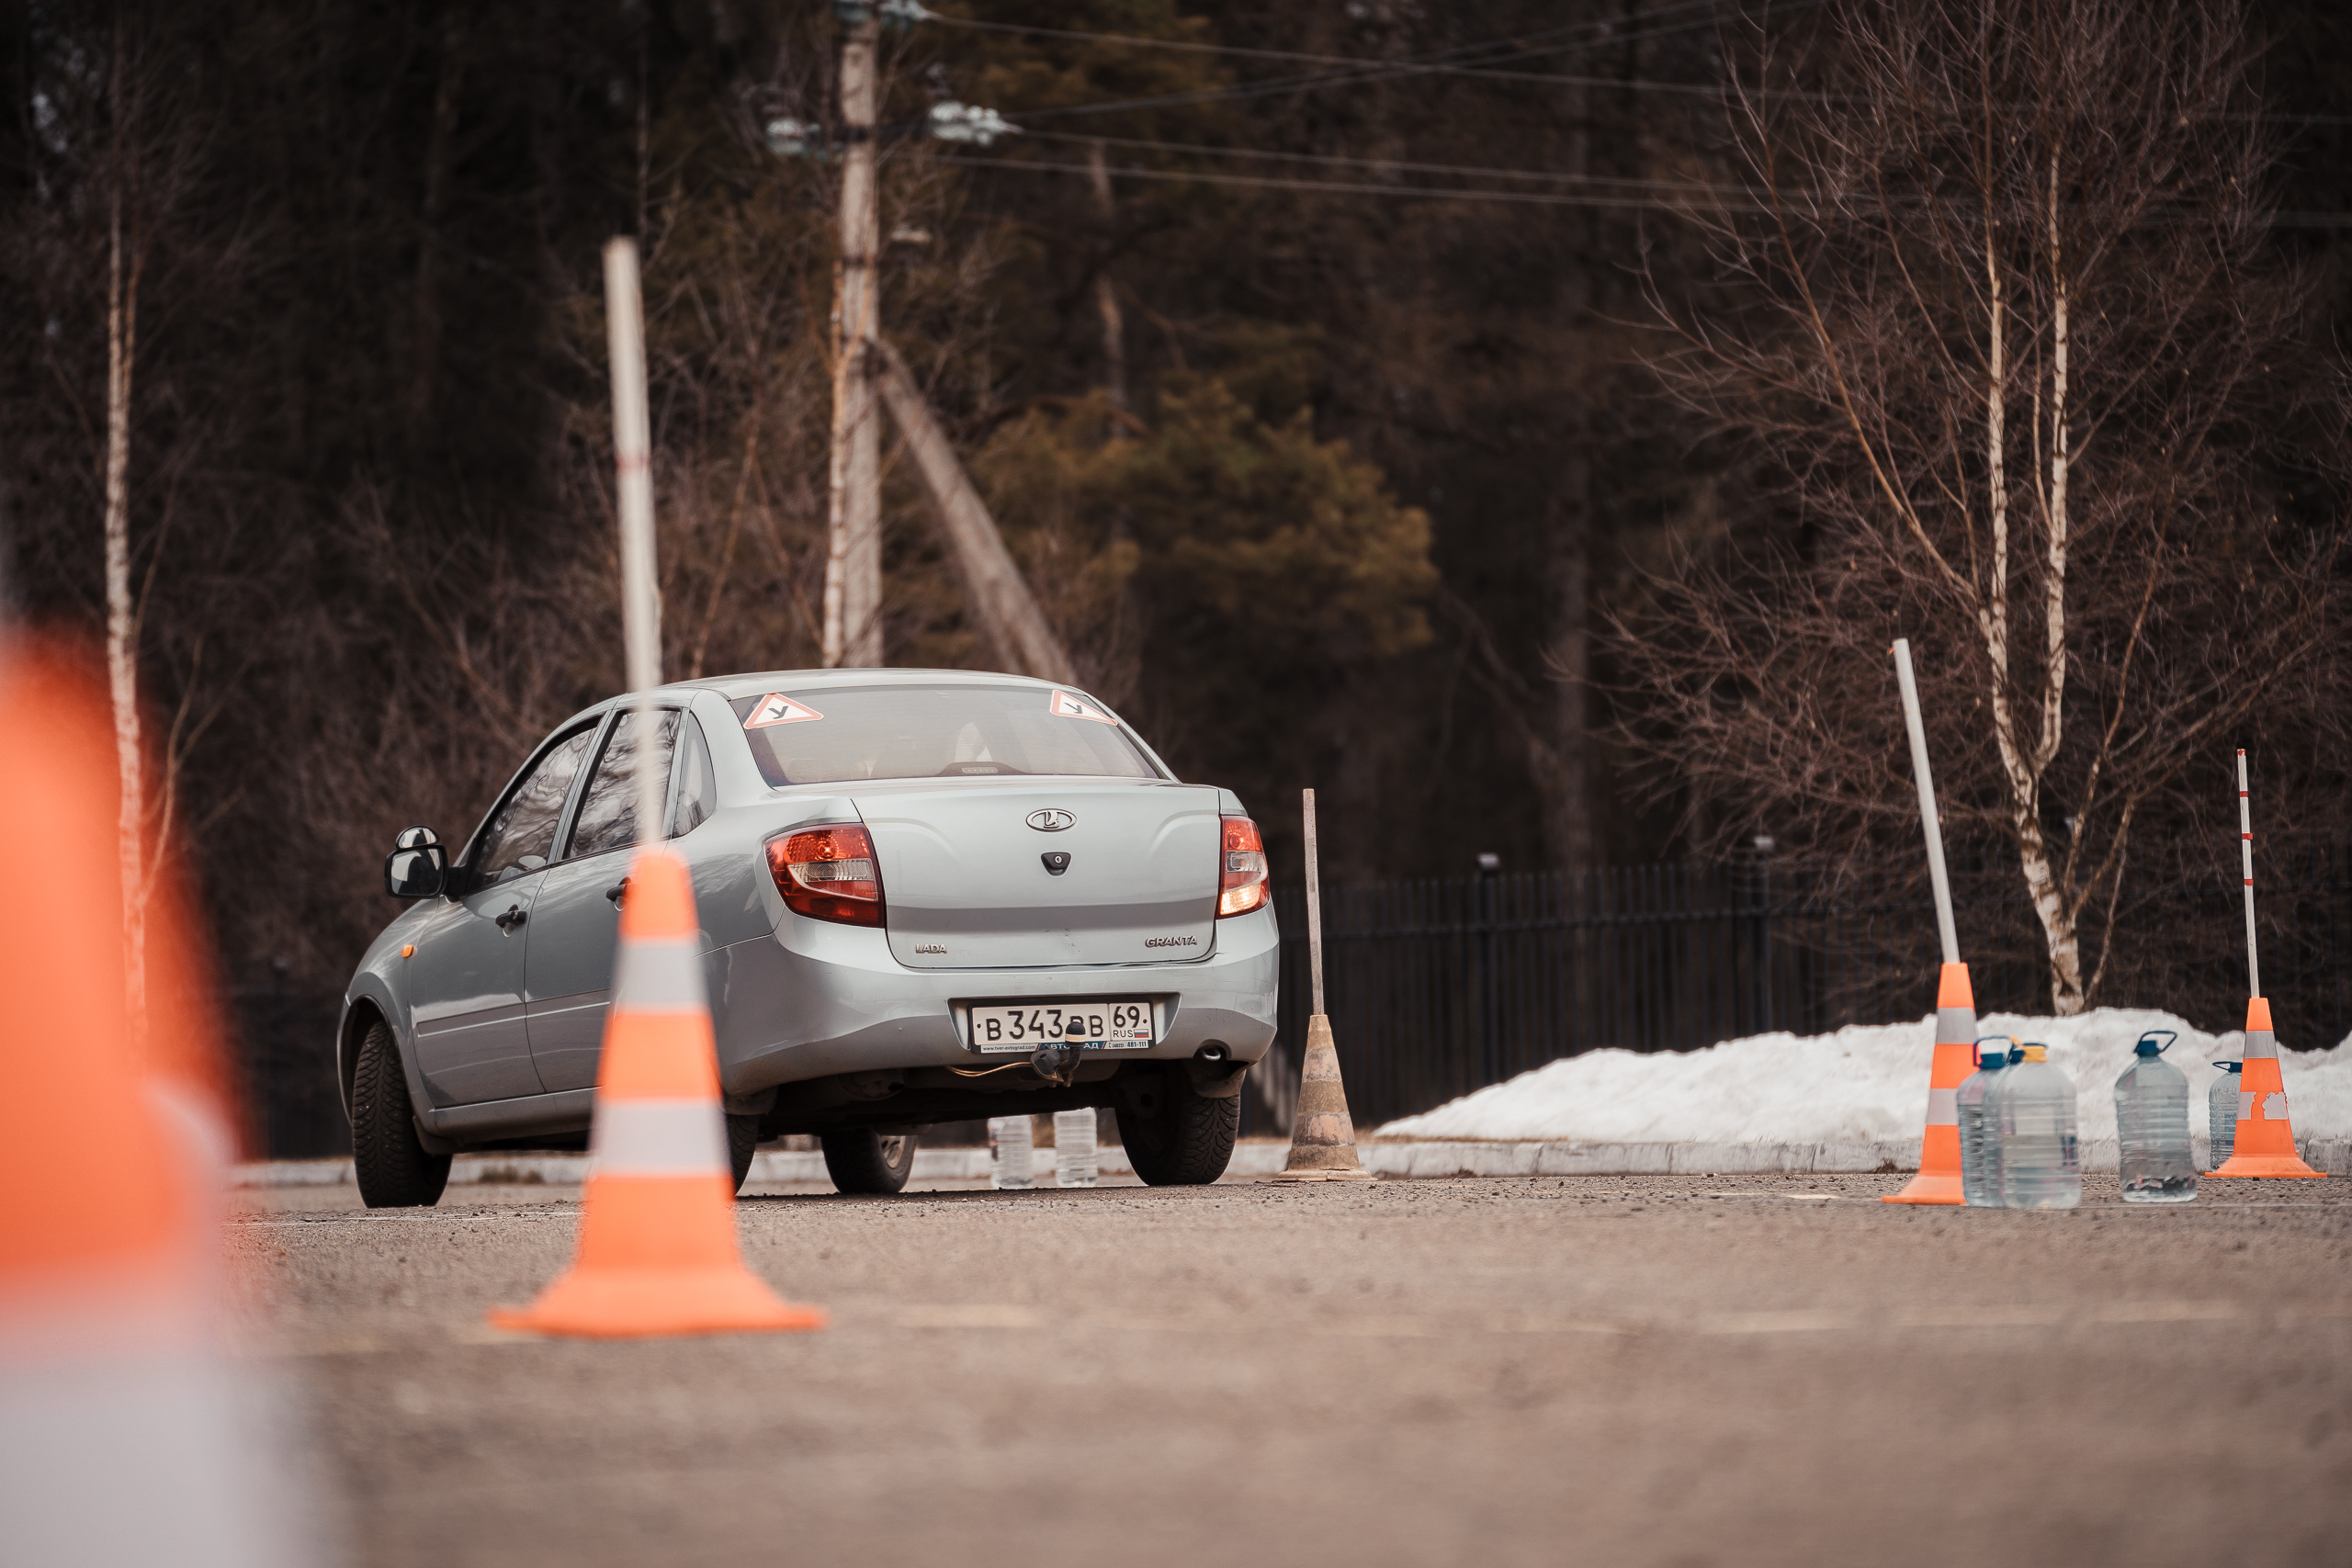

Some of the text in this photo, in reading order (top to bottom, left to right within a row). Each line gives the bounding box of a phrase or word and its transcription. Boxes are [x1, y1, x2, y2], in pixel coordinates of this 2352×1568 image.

[1145, 935, 1198, 948] GRANTA
[915, 943, 948, 954] LADA
[1113, 1005, 1140, 1028] 69
[1113, 1029, 1134, 1038] RUS
